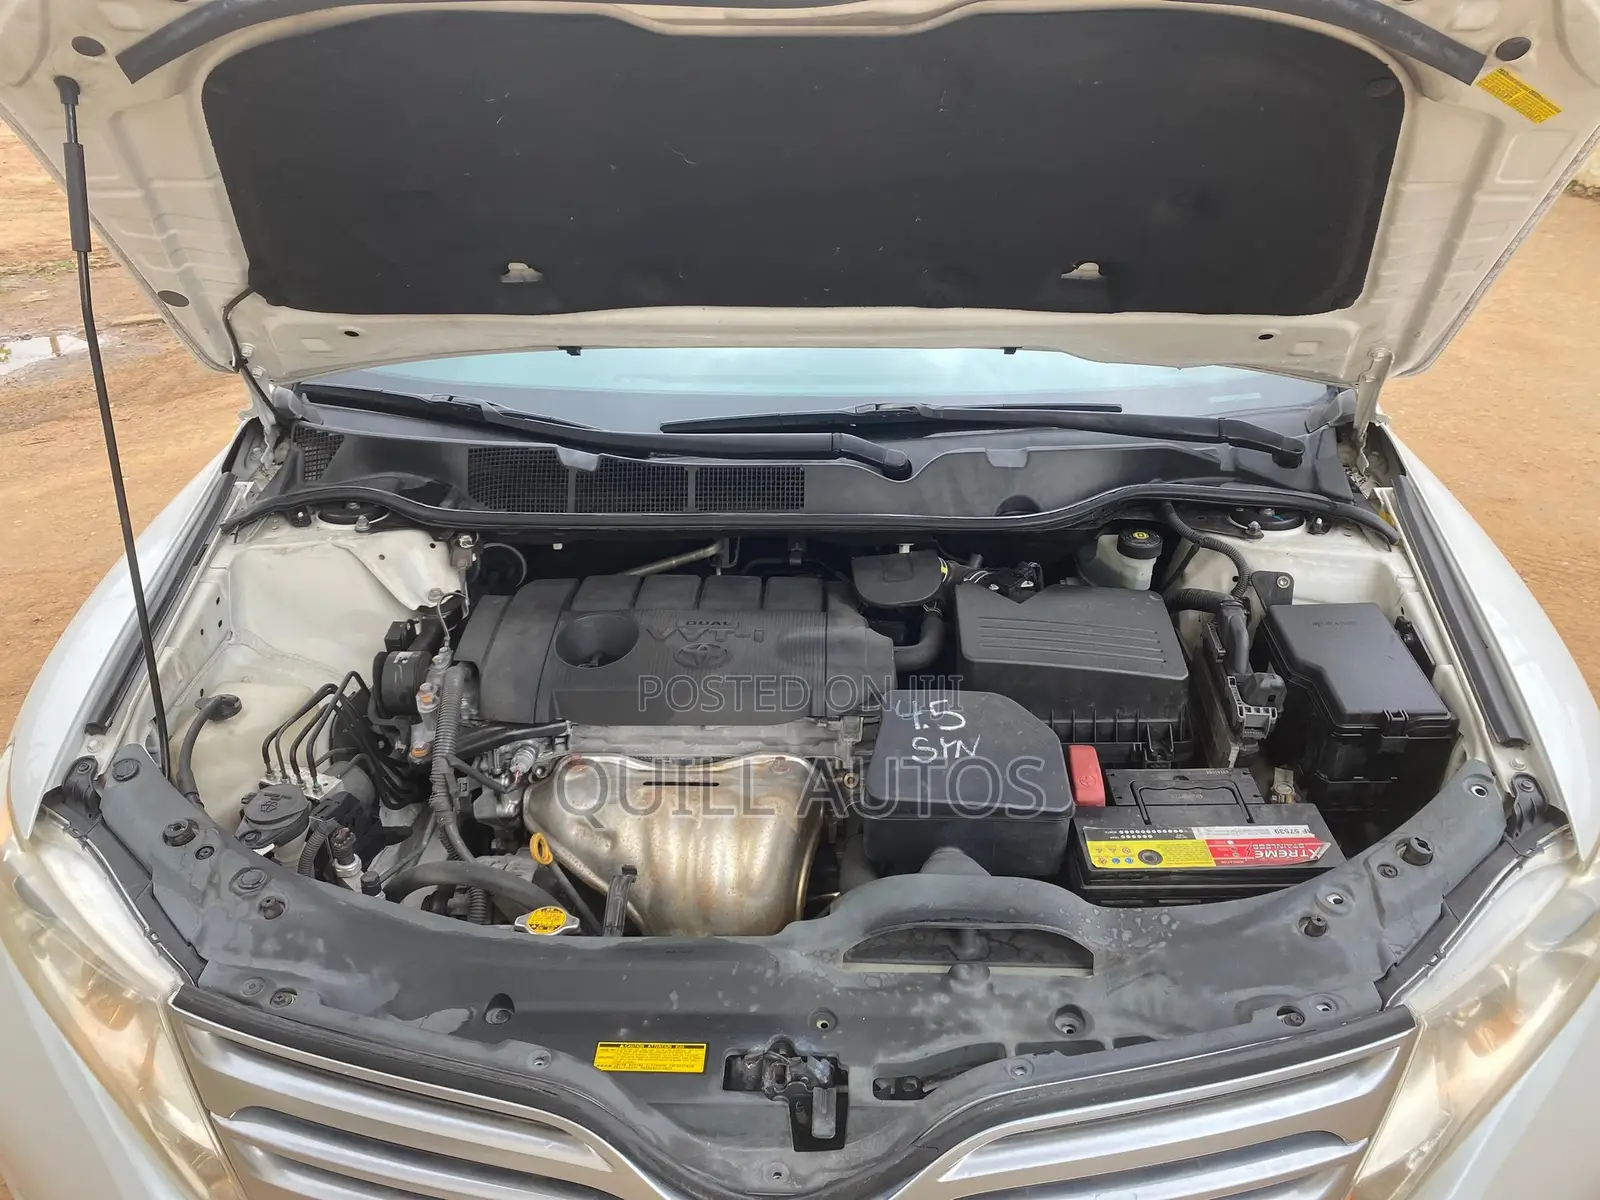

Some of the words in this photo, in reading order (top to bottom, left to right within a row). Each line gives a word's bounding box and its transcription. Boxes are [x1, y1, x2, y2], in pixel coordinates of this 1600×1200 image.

[895, 699, 967, 731] 4.5
[911, 734, 981, 764] SYN
[1254, 846, 1321, 860] XTREME
